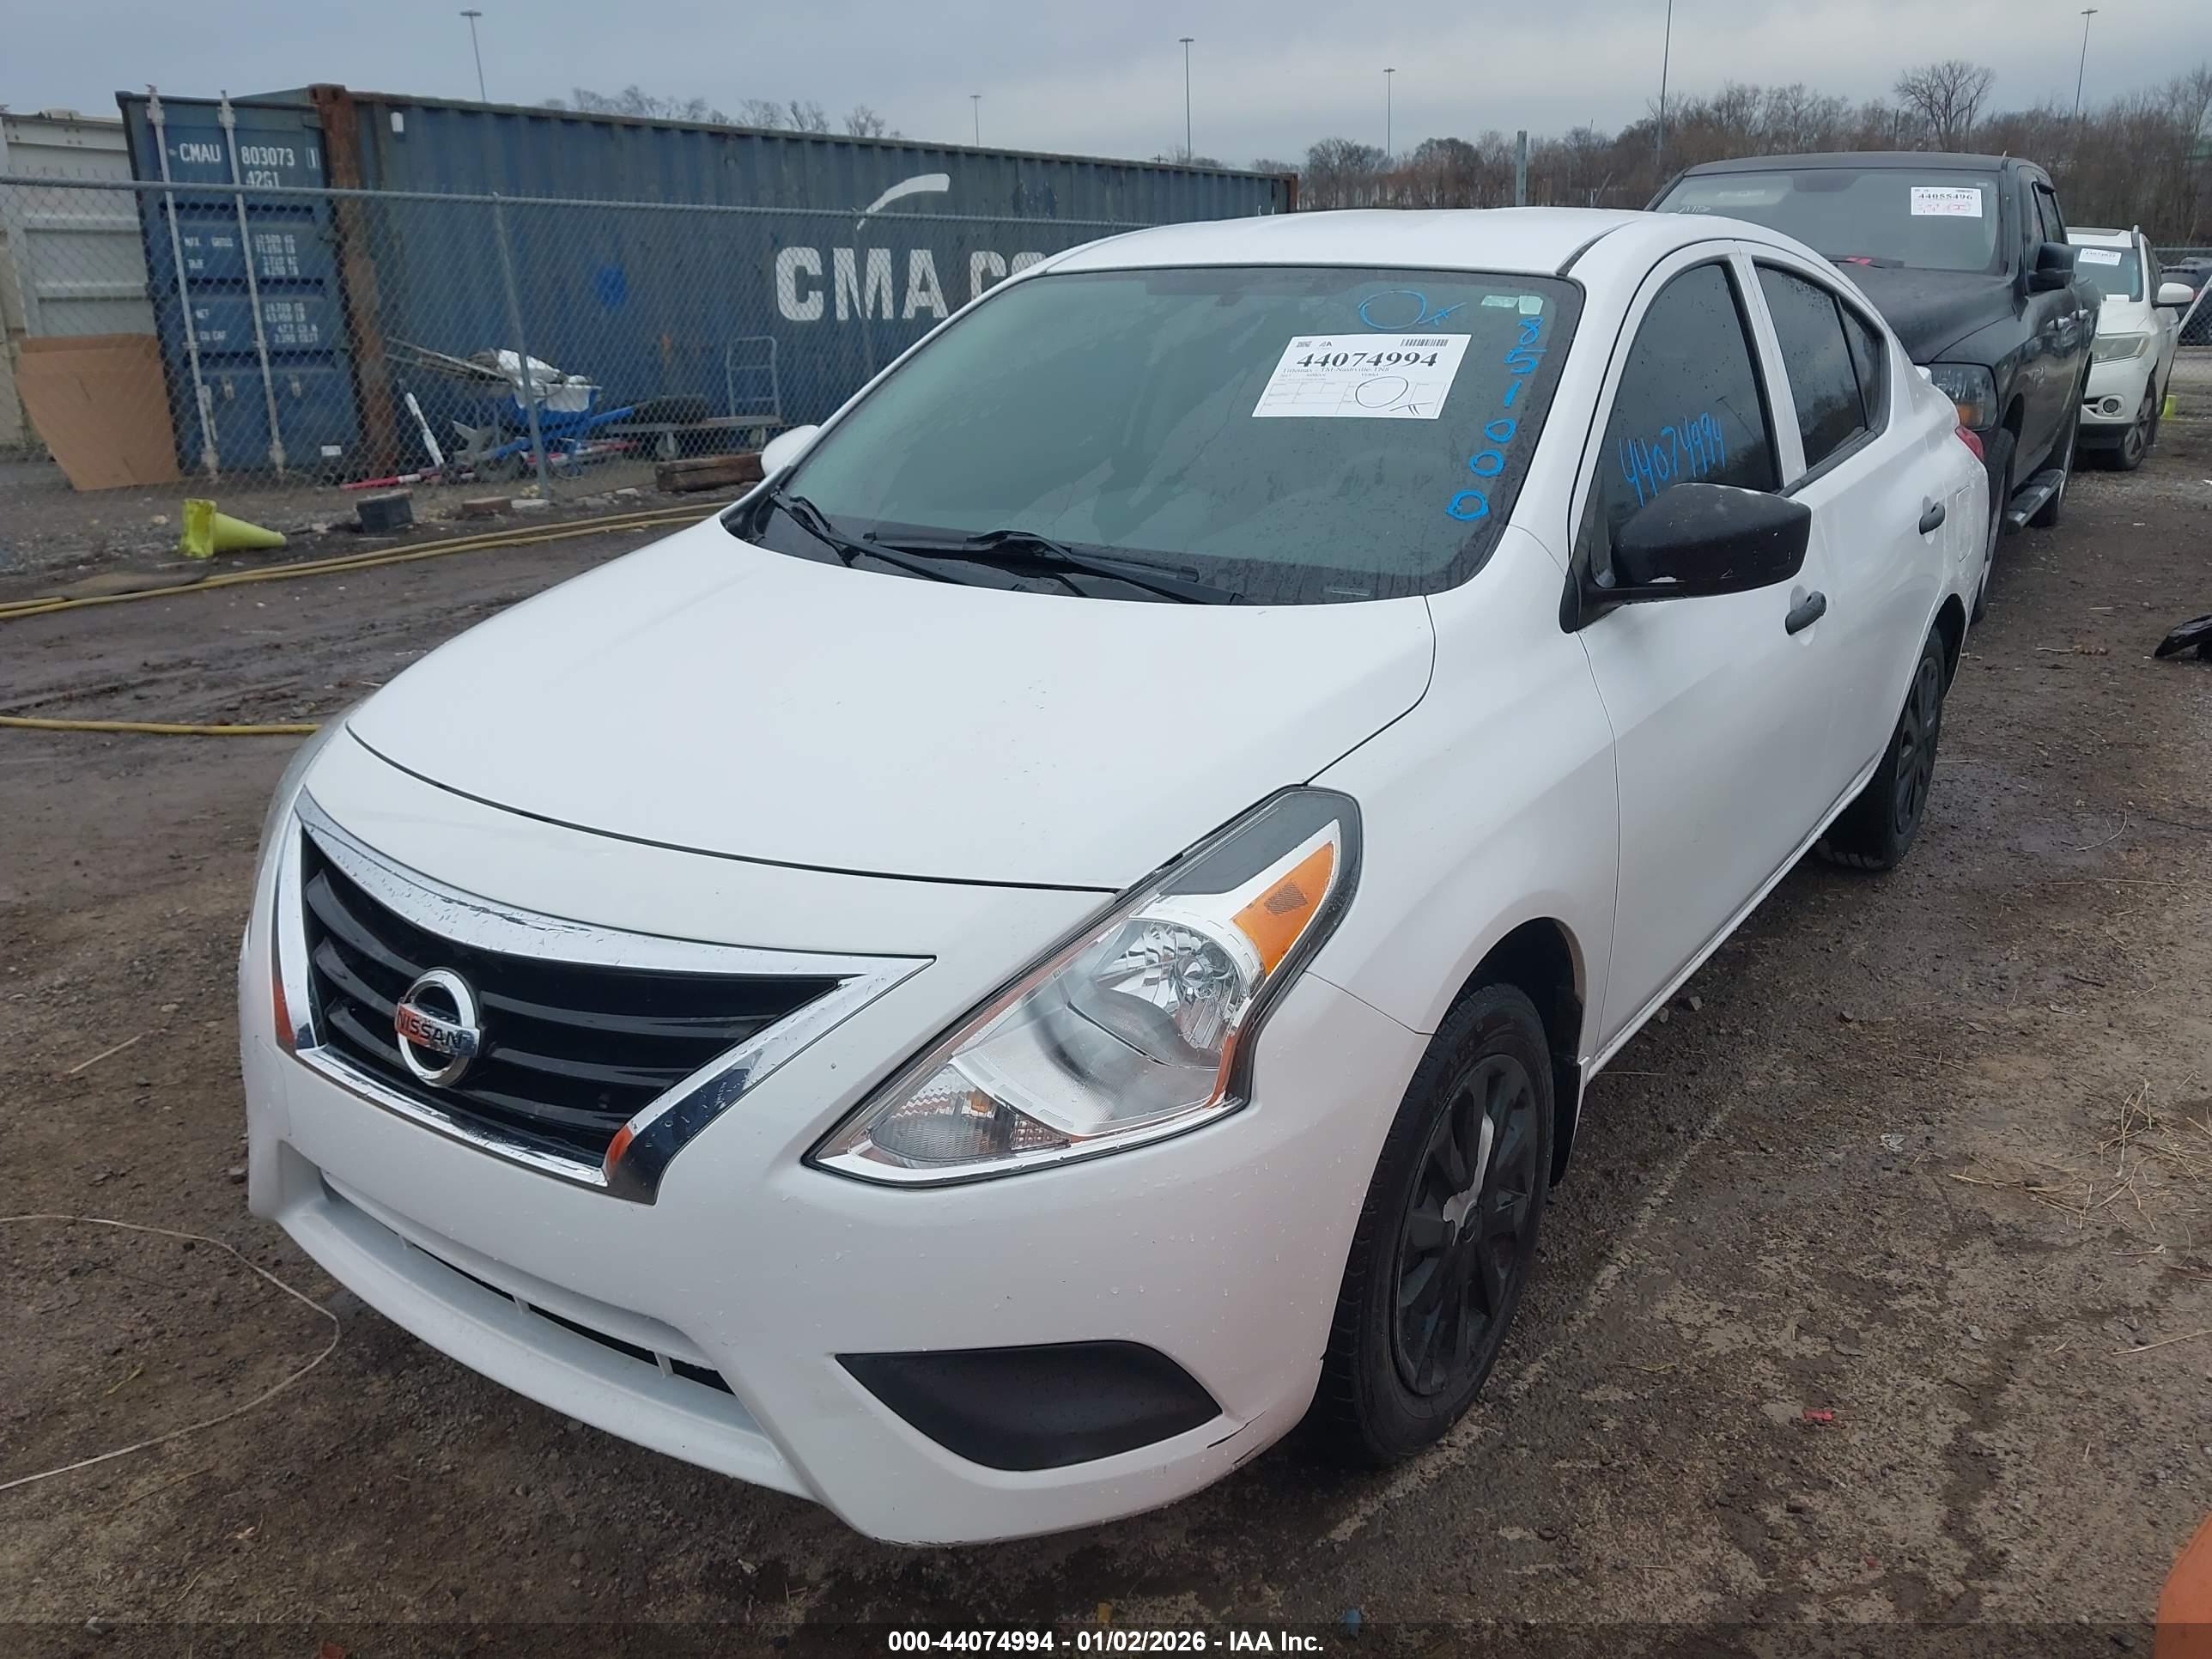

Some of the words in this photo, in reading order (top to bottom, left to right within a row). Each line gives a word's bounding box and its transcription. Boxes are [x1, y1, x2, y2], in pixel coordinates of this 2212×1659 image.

[179, 143, 221, 162] CMAU
[240, 146, 295, 167] 803073
[775, 246, 949, 321] CMA
[1297, 351, 1438, 368] 44074994
[1619, 412, 1726, 508] 44074994
[398, 1011, 470, 1049] NISSAN
